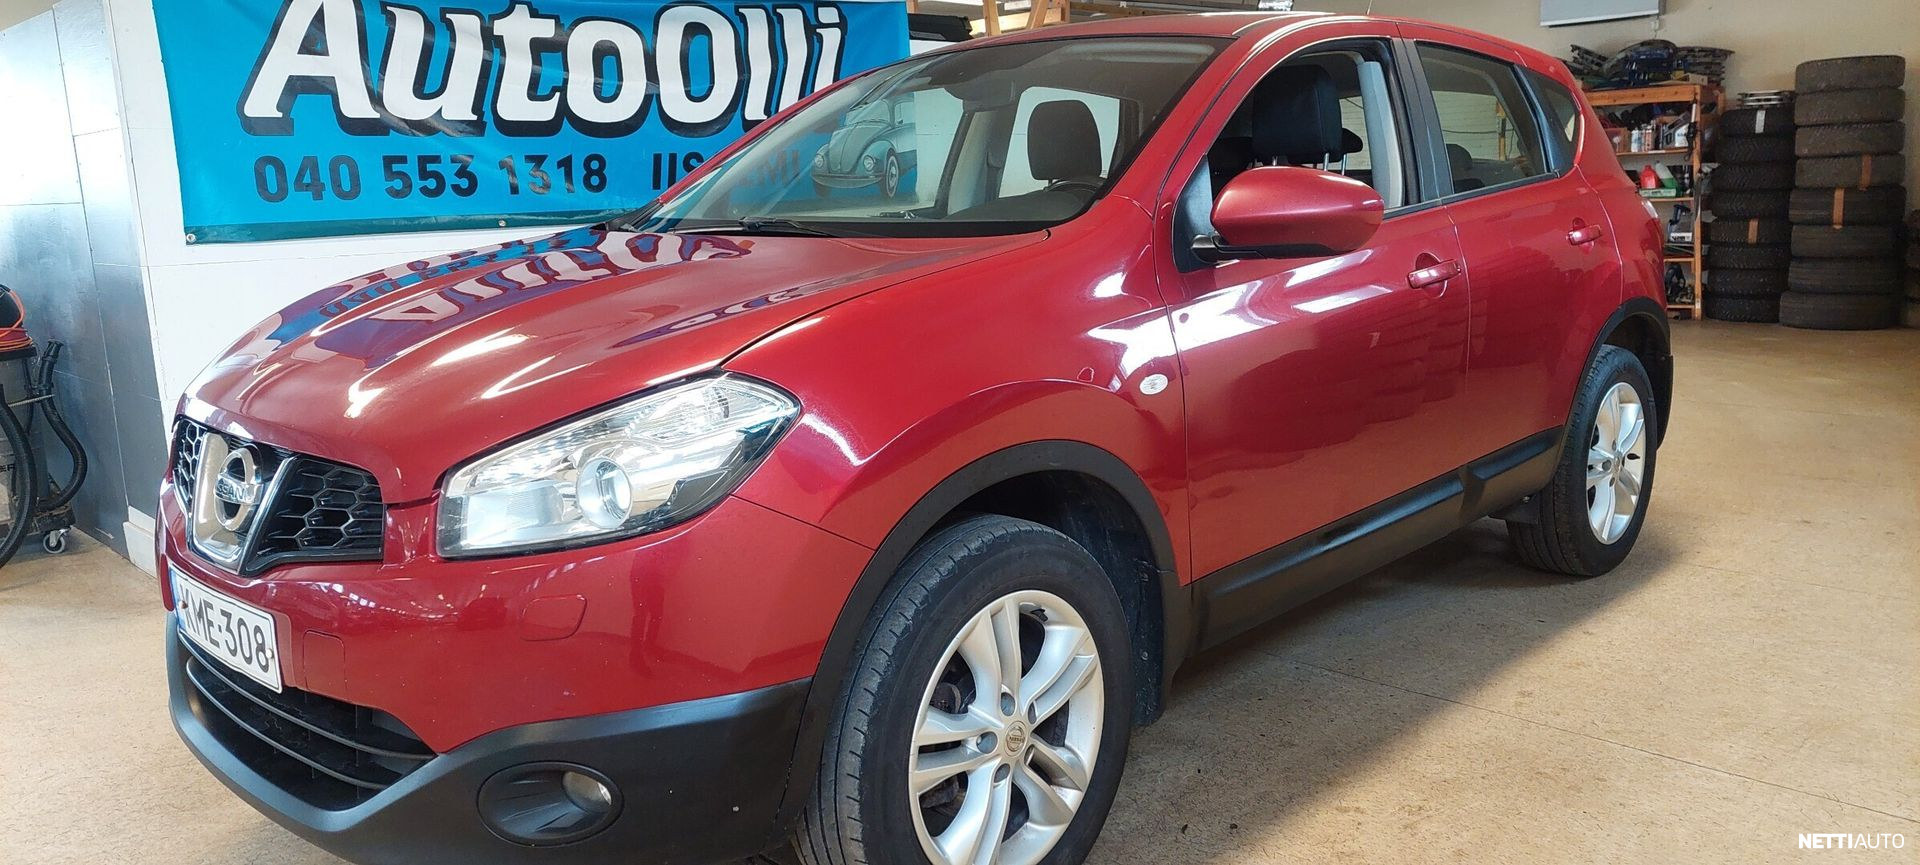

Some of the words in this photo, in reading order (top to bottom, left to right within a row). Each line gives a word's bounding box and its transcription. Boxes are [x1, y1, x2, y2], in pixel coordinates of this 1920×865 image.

[239, 0, 845, 132] AutoOlli
[254, 155, 361, 203] 040
[382, 154, 478, 199] 553
[499, 152, 608, 196] 1318
[179, 583, 270, 673] KME-308
